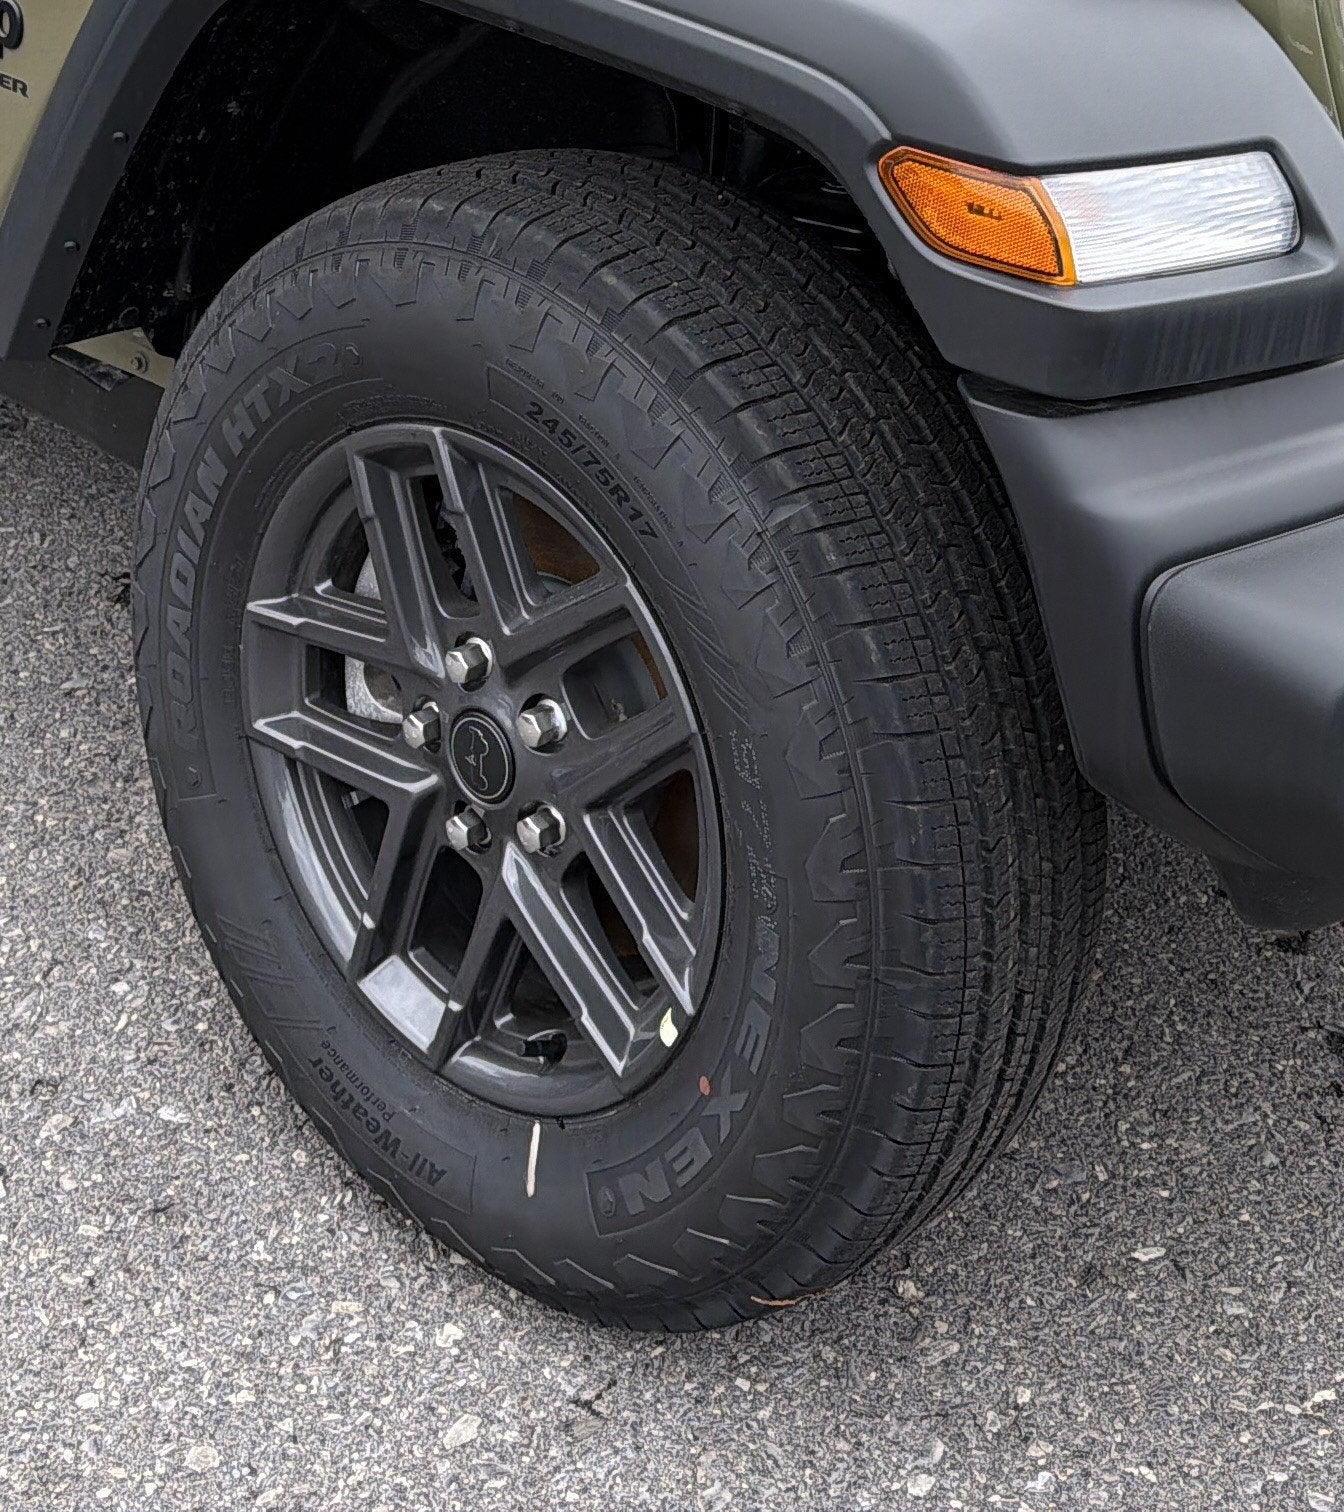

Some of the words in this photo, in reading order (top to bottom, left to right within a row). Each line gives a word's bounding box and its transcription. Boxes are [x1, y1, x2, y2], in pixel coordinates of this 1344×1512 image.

[525, 401, 658, 539] 245/75R17
[165, 444, 230, 748] ROADIAN
[308, 1056, 449, 1188] All-Weather
[320, 1039, 398, 1124] Performance
